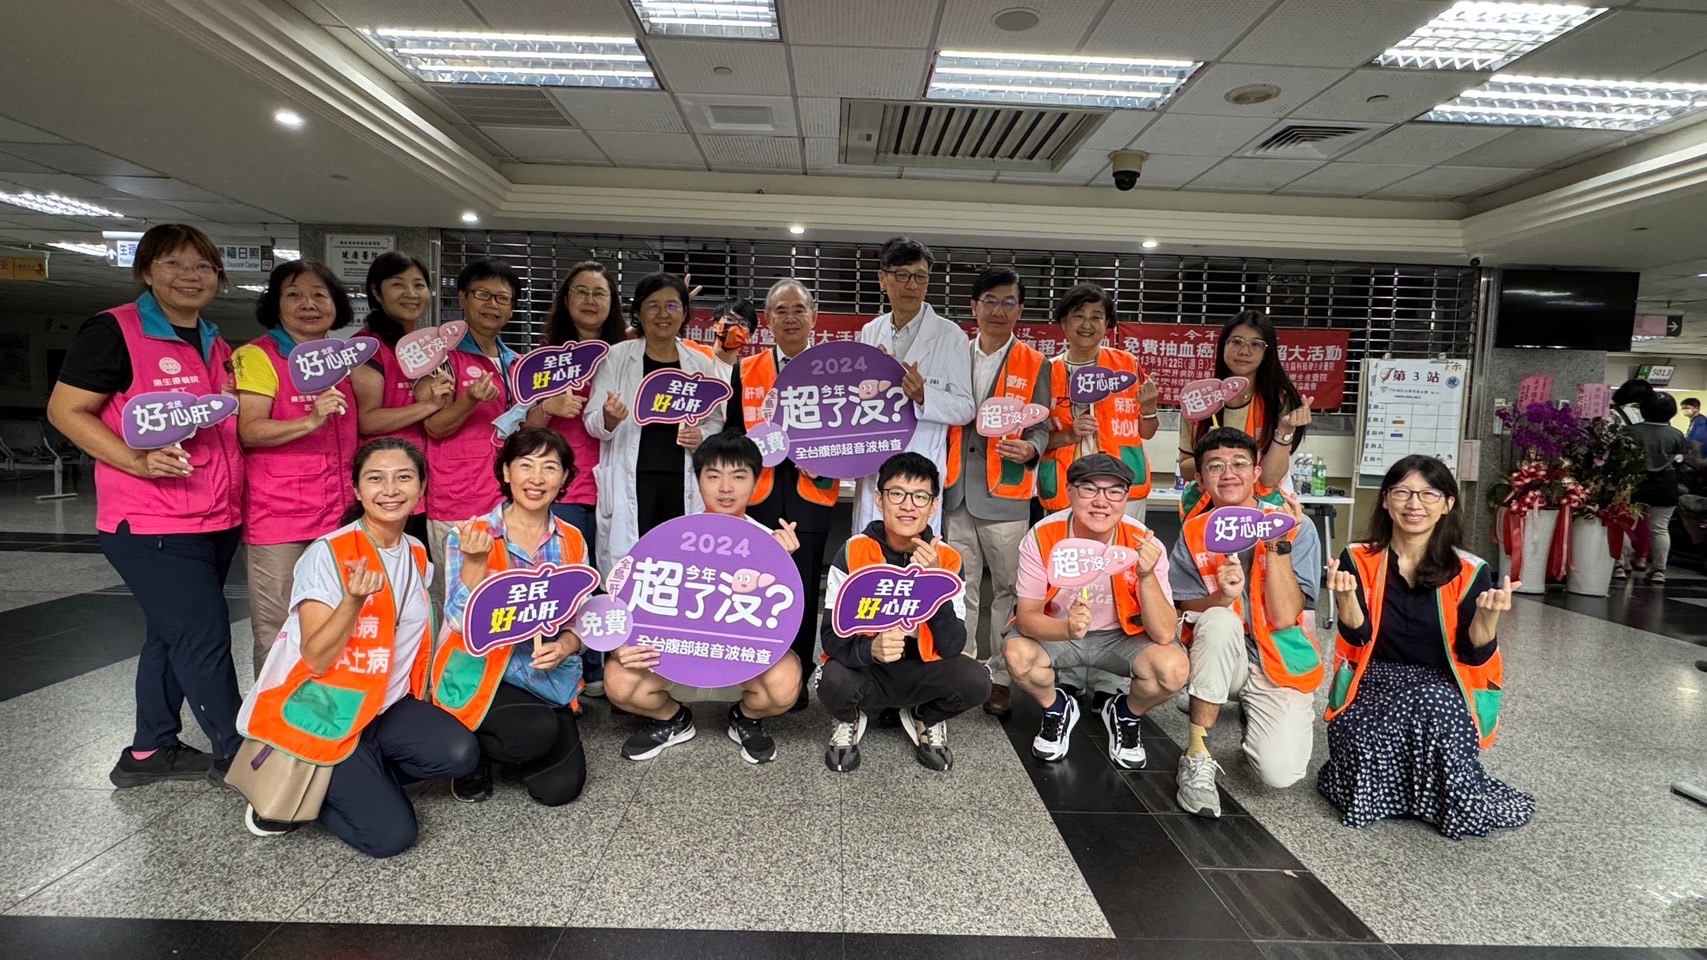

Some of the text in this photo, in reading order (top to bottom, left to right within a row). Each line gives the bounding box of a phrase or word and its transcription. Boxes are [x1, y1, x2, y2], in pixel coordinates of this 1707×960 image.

[295, 346, 358, 380] 好心肝
[543, 352, 573, 370] 全民
[811, 356, 868, 375] 2024
[532, 363, 582, 390] 好心肝
[666, 379, 698, 397] 全民
[1076, 373, 1120, 394] 好心肝
[651, 393, 702, 413] 好心肝
[820, 384, 846, 398] 今年
[132, 402, 211, 435] 好心肝
[752, 431, 786, 457] 免費
[795, 438, 903, 460] 全台腹部超音波檢查
[1214, 516, 1272, 542] 好心肝
[680, 531, 750, 558] 2024
[608, 558, 632, 595] 全島一肝
[686, 564, 716, 583] 今年
[506, 580, 550, 604] 全民
[874, 578, 915, 596] 全民
[489, 599, 559, 634] 好心肝
[854, 597, 921, 620] 好心肝
[580, 609, 627, 637] 免費
[636, 634, 772, 665] 全台腹部超音波檢查
